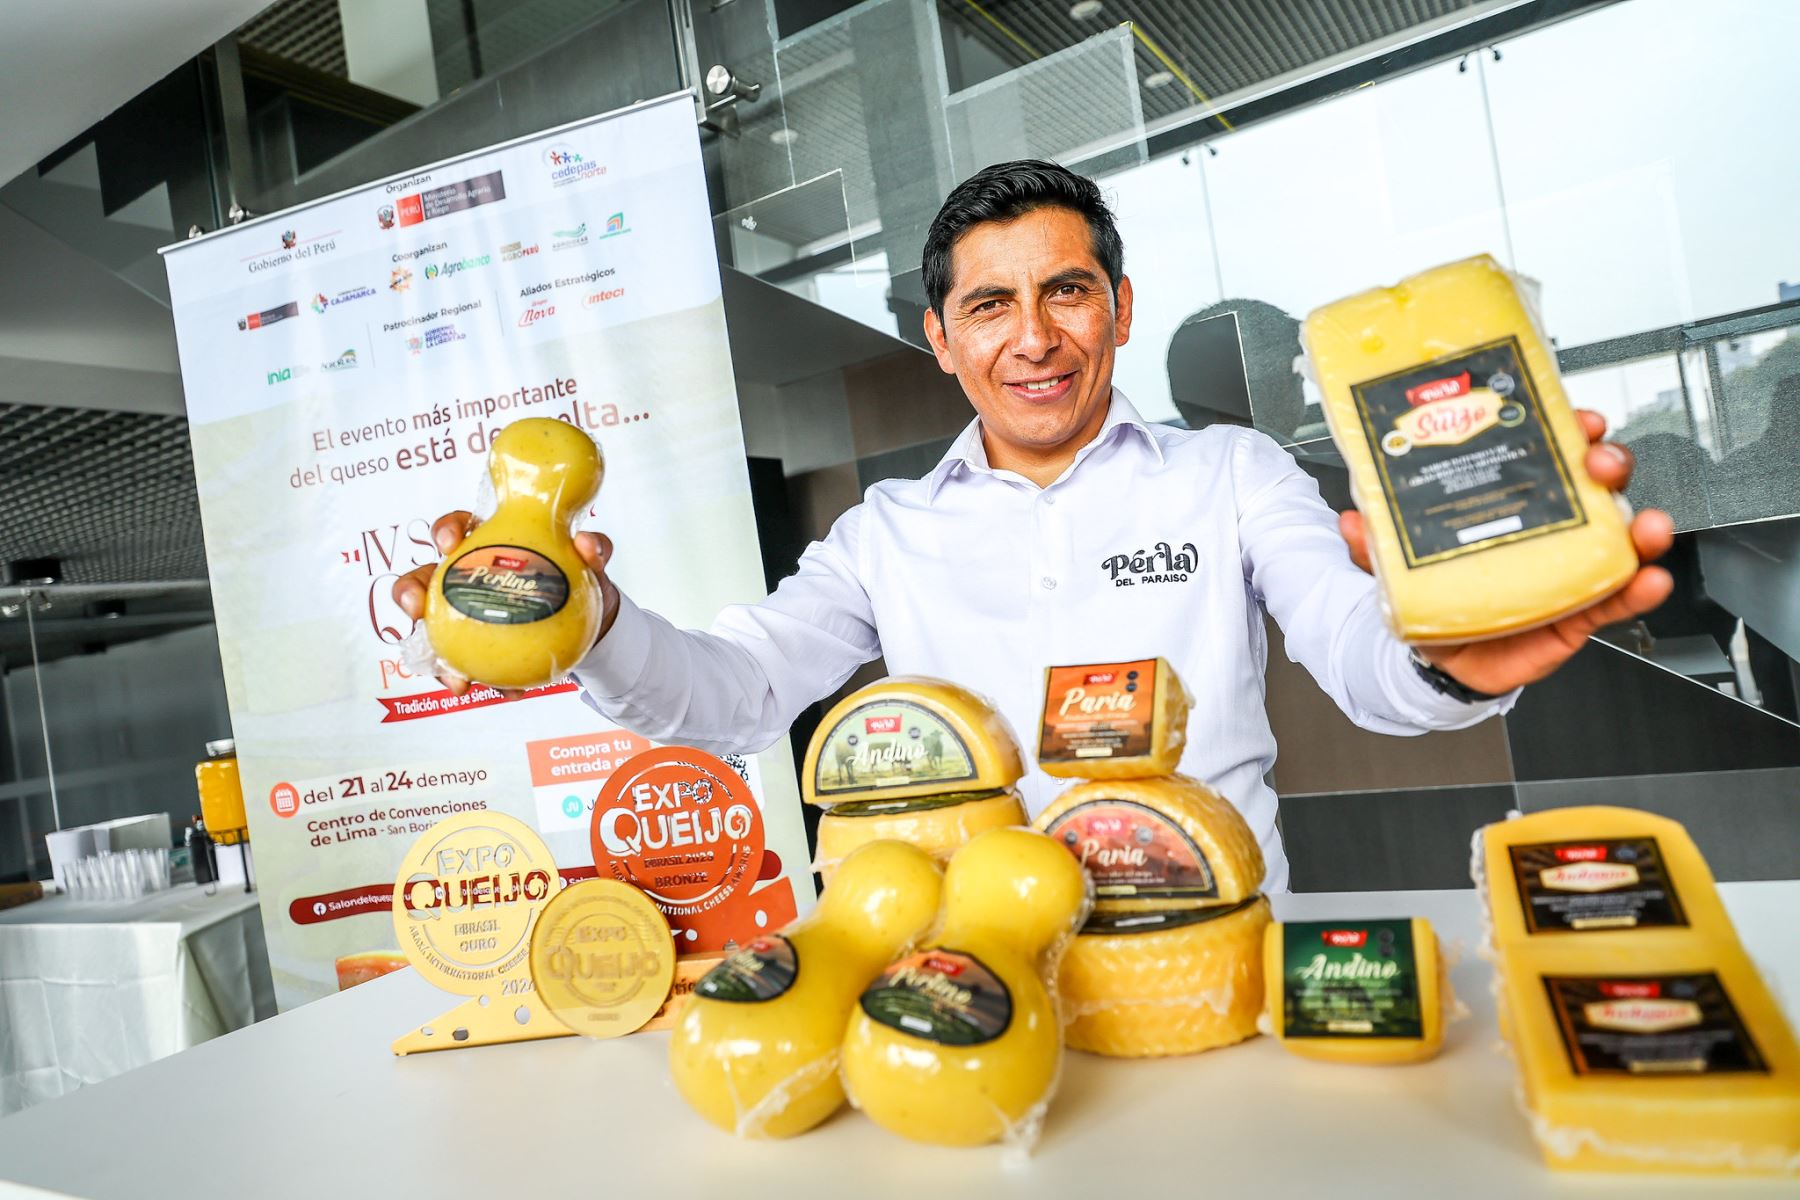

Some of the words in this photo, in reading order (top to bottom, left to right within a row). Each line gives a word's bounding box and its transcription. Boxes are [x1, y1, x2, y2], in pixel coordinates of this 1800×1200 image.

[386, 175, 432, 193] Organizan
[552, 160, 597, 181] cedepas
[581, 166, 607, 180] norte
[249, 253, 292, 273] Gobierno
[295, 247, 312, 261] del
[313, 241, 336, 256] Perú
[392, 241, 448, 262] Coorganizan
[441, 255, 491, 278] Agrobanco
[520, 281, 552, 297] Aliados
[555, 268, 615, 288] Estratégicos
[383, 311, 438, 332] Patrocinador
[441, 300, 482, 318] Regional
[313, 429, 335, 451] El
[340, 418, 407, 447] evento
[413, 403, 451, 430] más
[456, 378, 577, 419] importante
[290, 466, 322, 489] del
[330, 457, 389, 486] queso
[396, 428, 457, 470] está
[1115, 578, 1135, 587] DEL
[1142, 574, 1188, 584] PARAISO
[394, 695, 439, 715] Tradición
[440, 692, 459, 709] que
[459, 692, 470, 705] se
[1058, 687, 1137, 716] Paria
[550, 743, 611, 762] Compra
[613, 739, 631, 751] tu
[847, 738, 928, 768] Andino
[551, 759, 611, 777] entrada
[304, 787, 334, 805] del
[339, 776, 366, 798] 21
[370, 778, 384, 793] al
[385, 770, 413, 791] 24
[416, 773, 438, 788] de
[441, 769, 487, 786] mayo
[632, 778, 713, 812] EXPO
[307, 812, 365, 832] Centro
[369, 808, 386, 822] de
[389, 800, 487, 820] Convenciones
[600, 804, 753, 857] QUEIJO
[310, 835, 331, 847] de
[336, 827, 377, 842] Lima
[387, 824, 406, 836] San
[437, 843, 515, 876] EXPO
[1081, 839, 1148, 869] Paria
[403, 869, 551, 921] QUEIJO
[654, 872, 709, 889] BRONZE
[704, 885, 734, 910] CHEESE
[460, 937, 497, 952] OURO
[1295, 952, 1401, 981] Andino
